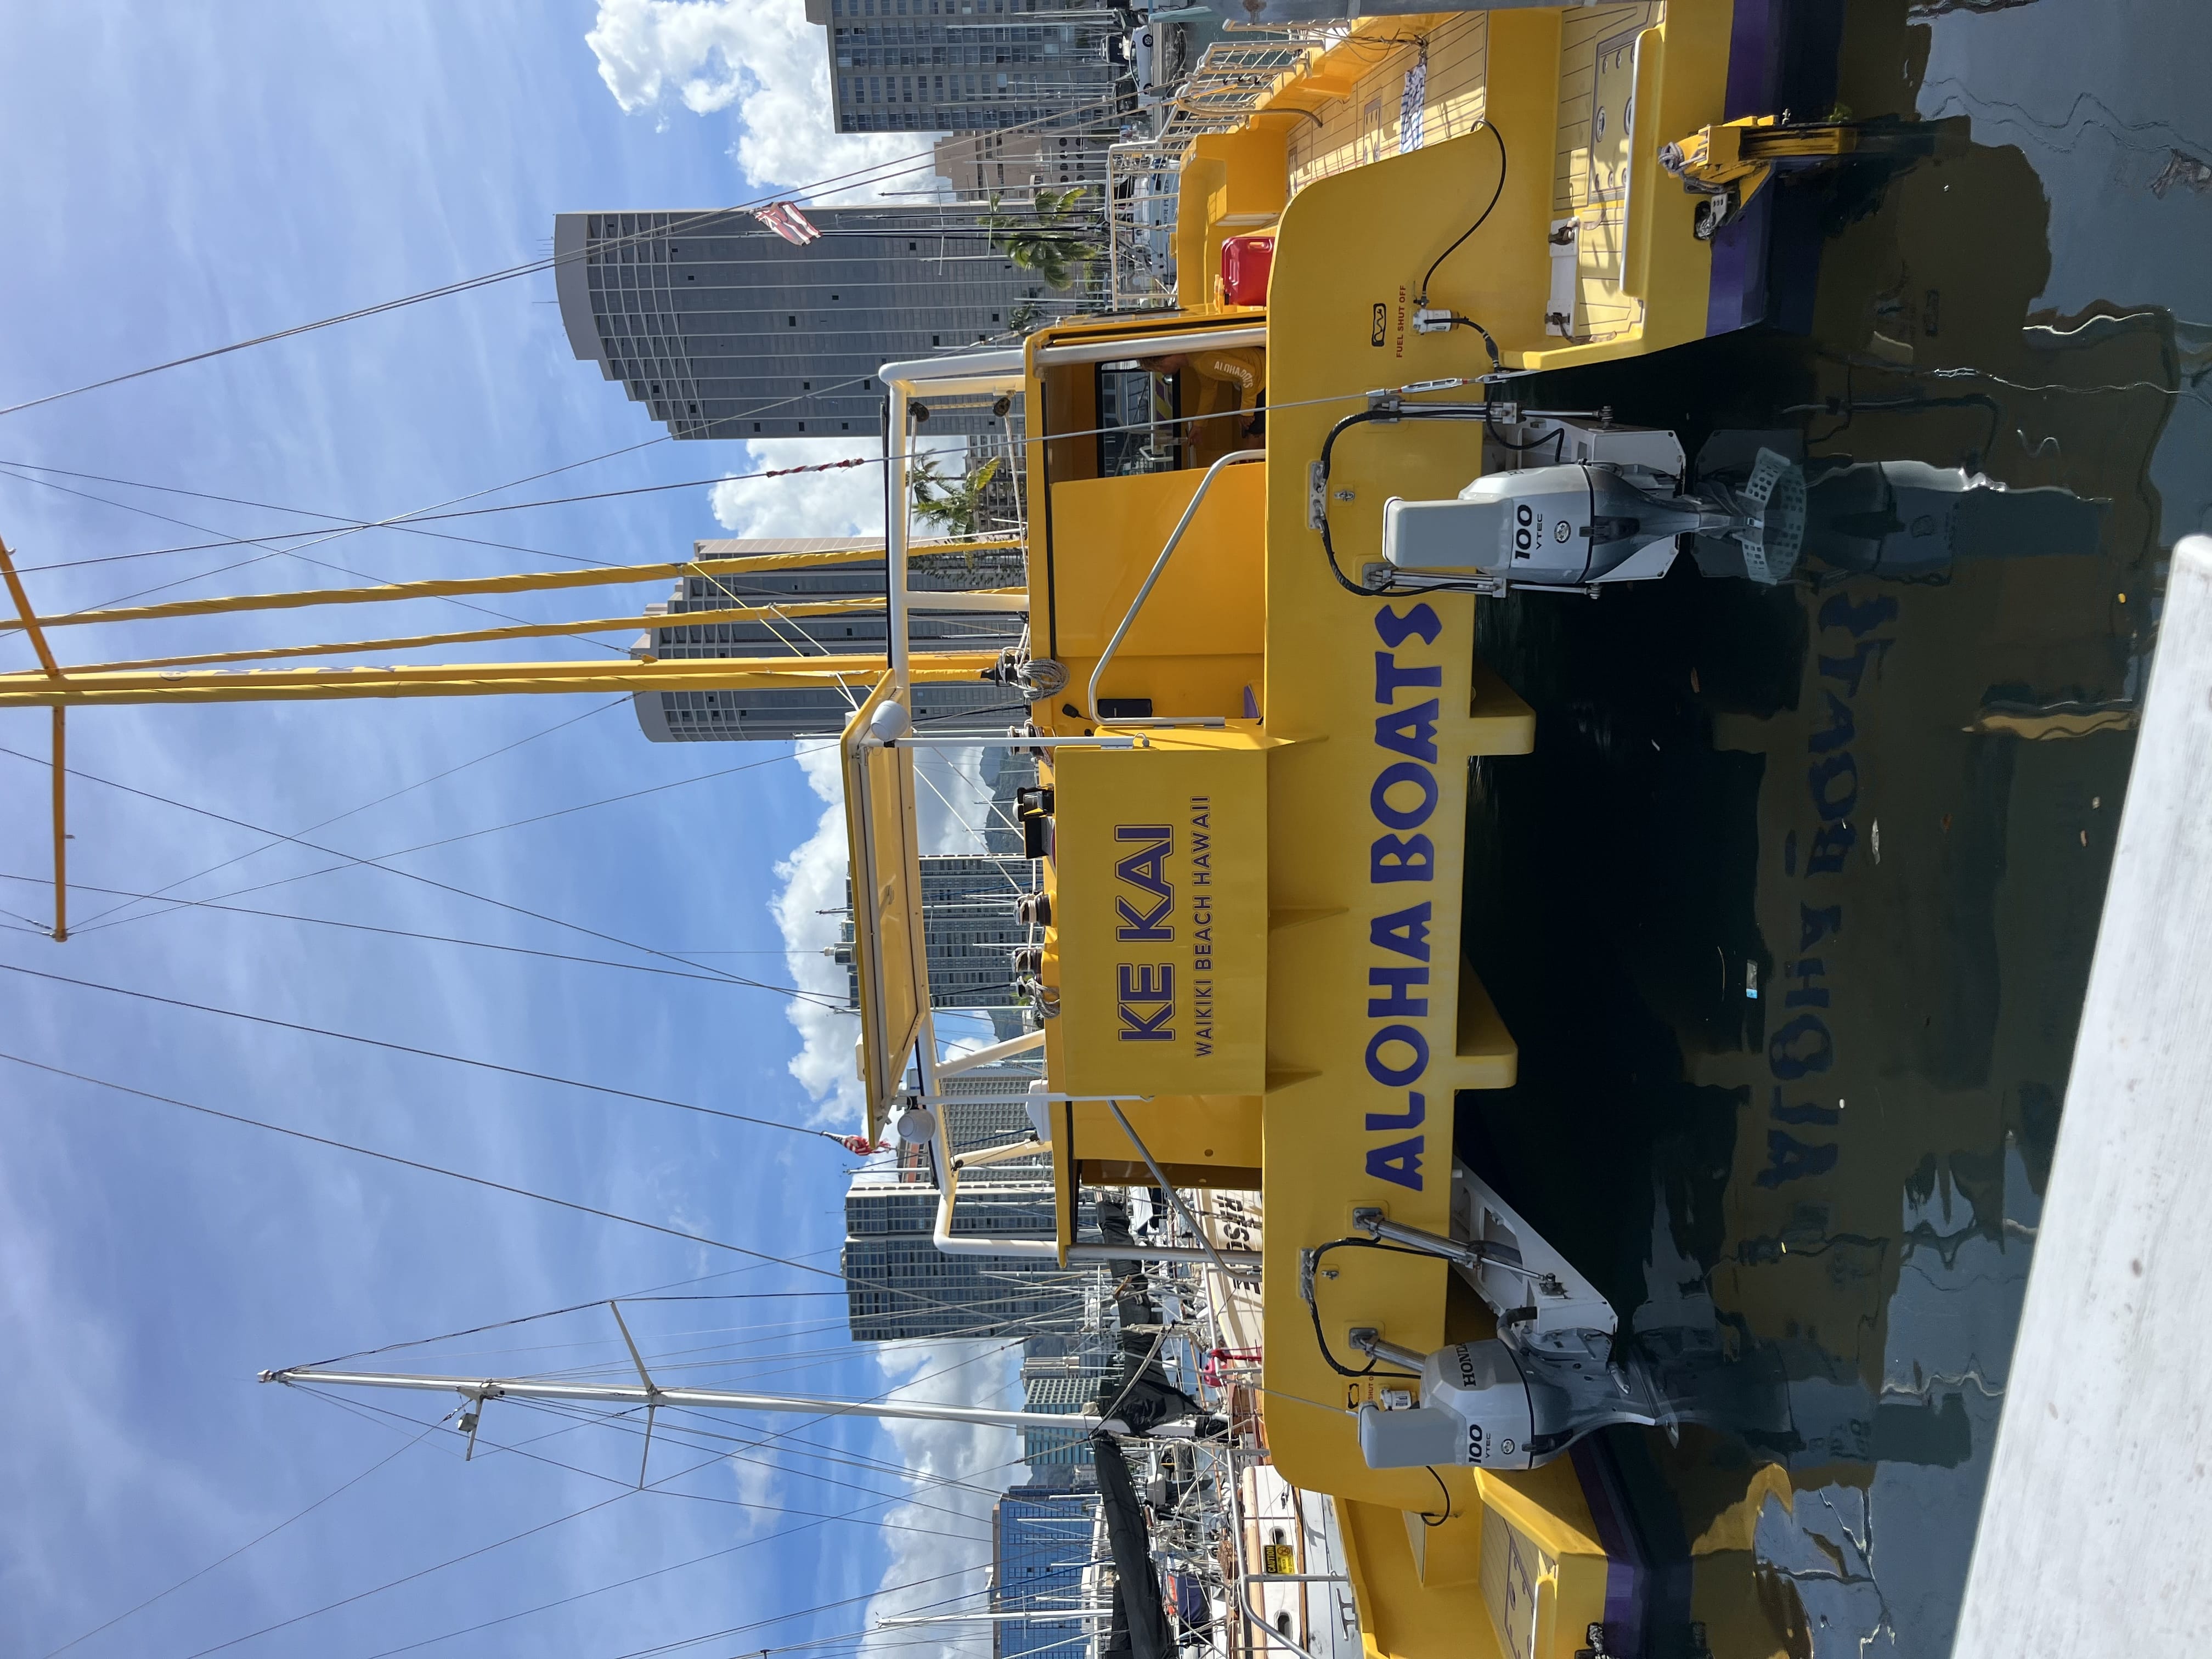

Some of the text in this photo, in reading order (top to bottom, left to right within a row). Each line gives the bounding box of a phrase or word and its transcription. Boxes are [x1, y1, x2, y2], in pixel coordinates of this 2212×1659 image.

[1515, 505, 1532, 560] 100
[1114, 825, 1175, 1041] KE KAI
[1189, 795, 1214, 1058] WAIKIKI BEACH HAWAII
[1365, 603, 1442, 1192] ALOHA BOATS
[1469, 1424, 1482, 1463] 100
[1266, 1546, 1276, 1572] CAUTION
